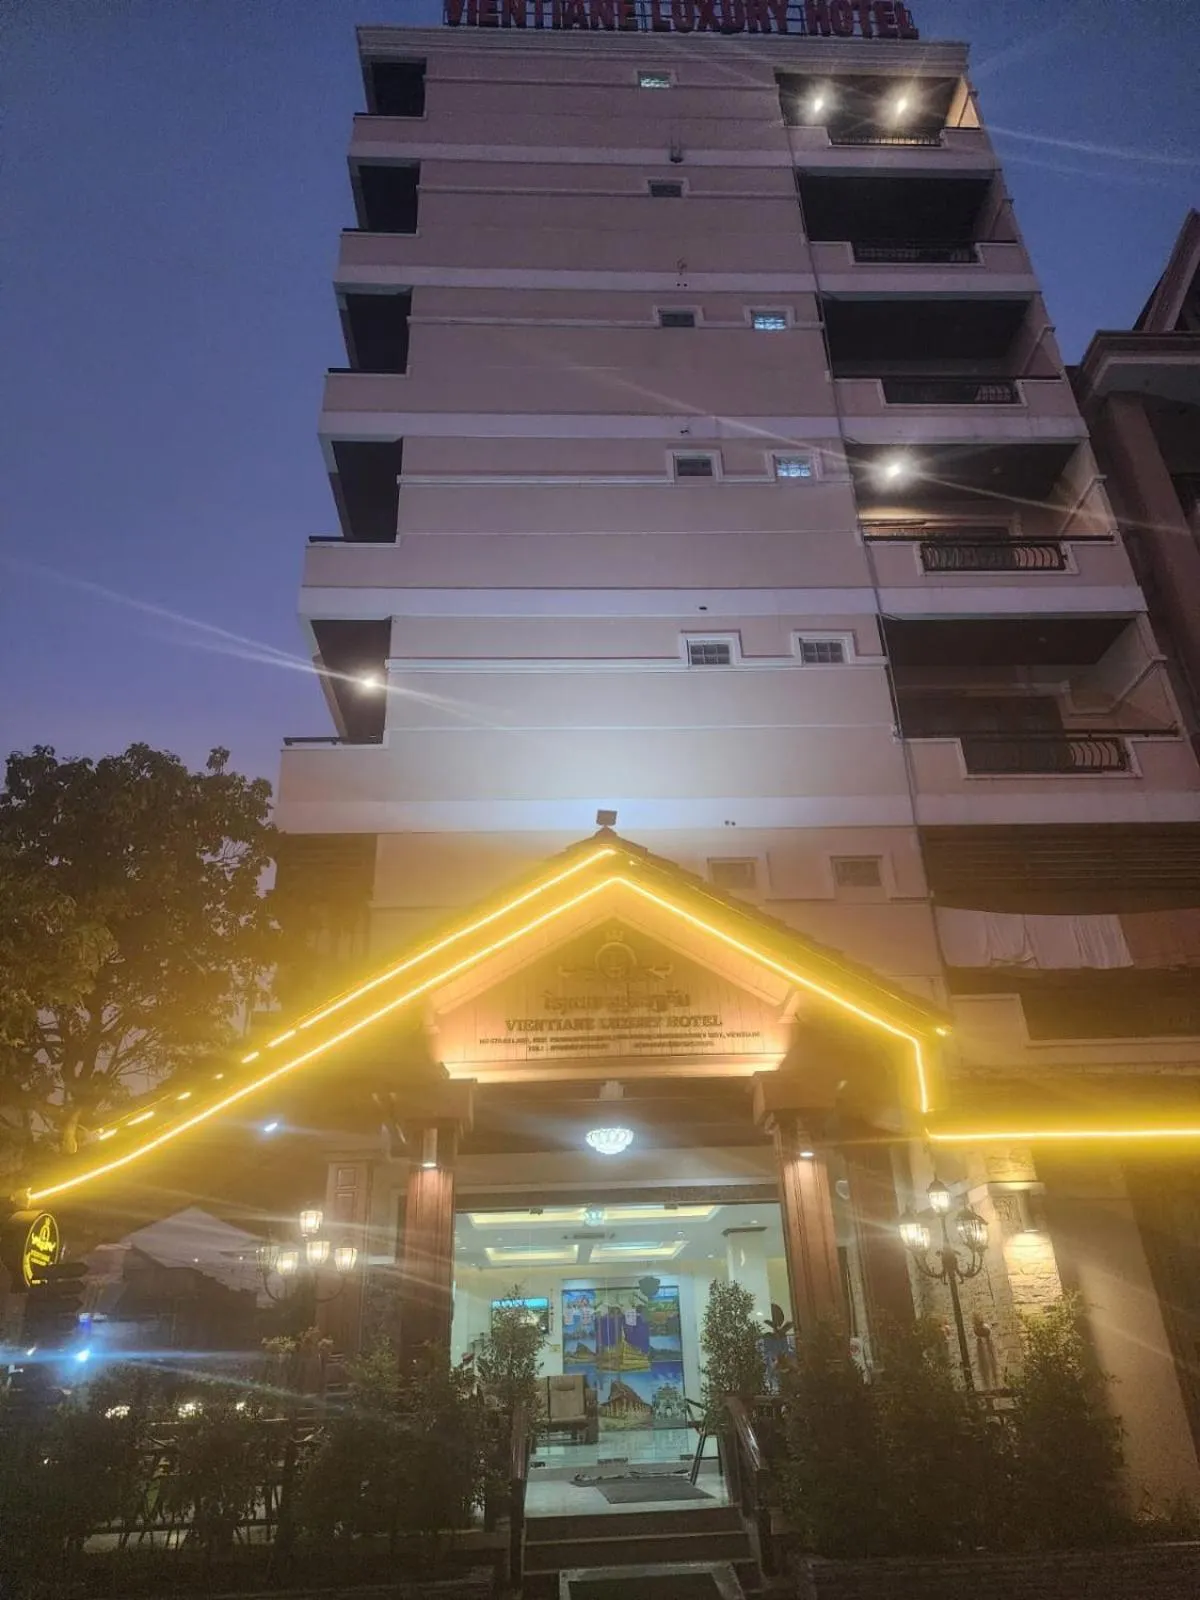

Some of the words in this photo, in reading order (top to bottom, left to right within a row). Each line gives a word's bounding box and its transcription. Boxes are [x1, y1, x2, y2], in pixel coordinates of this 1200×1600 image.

[443, 0, 639, 31] VIENTIANE
[801, 0, 919, 40] HOTEL
[505, 1018, 597, 1032] VIENTIANE
[666, 1015, 723, 1028] HOTEL
